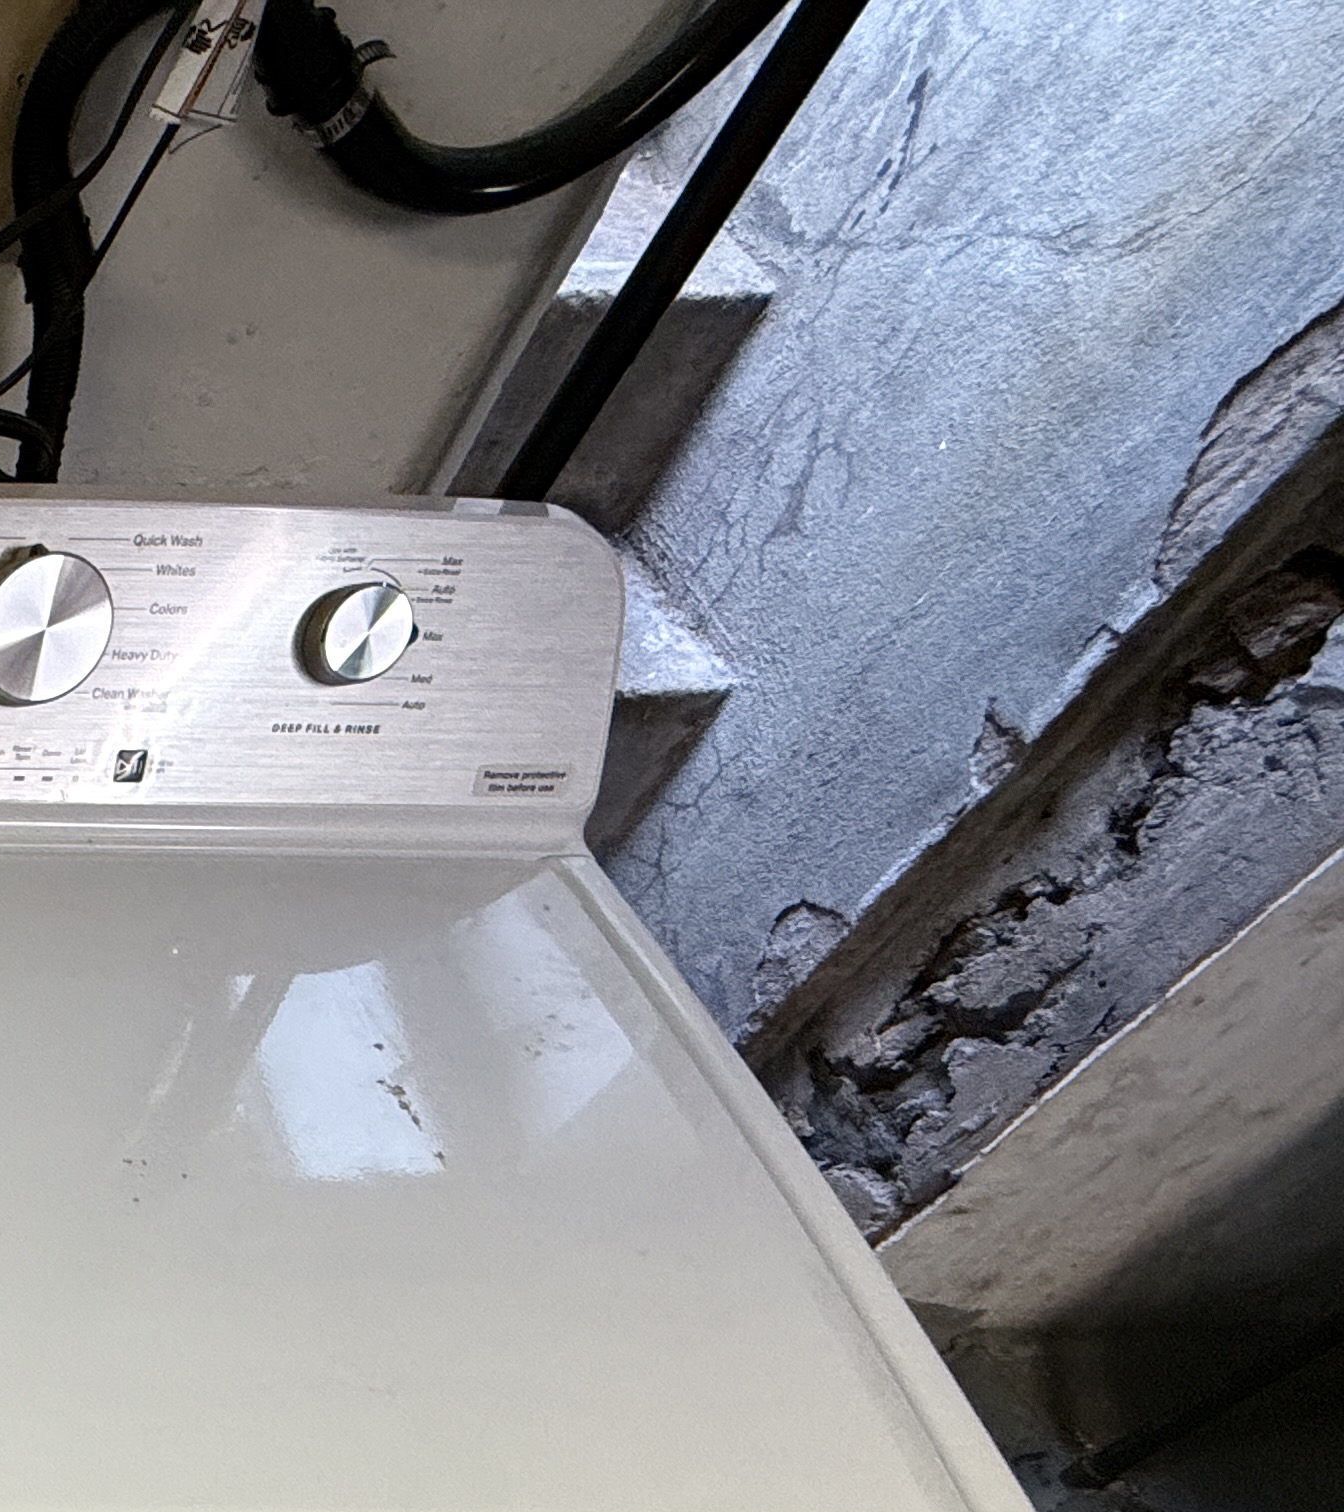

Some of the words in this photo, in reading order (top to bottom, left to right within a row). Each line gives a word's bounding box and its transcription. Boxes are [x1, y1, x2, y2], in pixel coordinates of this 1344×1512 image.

[133, 533, 168, 548] Quick
[170, 534, 203, 547] Wash
[156, 564, 196, 577] Whites
[431, 584, 456, 595] Auto
[149, 602, 188, 615] Colors
[112, 648, 148, 663] Heavy
[92, 687, 124, 700] Clean
[402, 700, 426, 711] Auto
[272, 723, 302, 733] DEEP
[305, 724, 331, 734] FILL
[333, 724, 342, 734] &
[344, 724, 381, 735] RINSE
[484, 770, 520, 779] Remove
[507, 783, 536, 792] before
